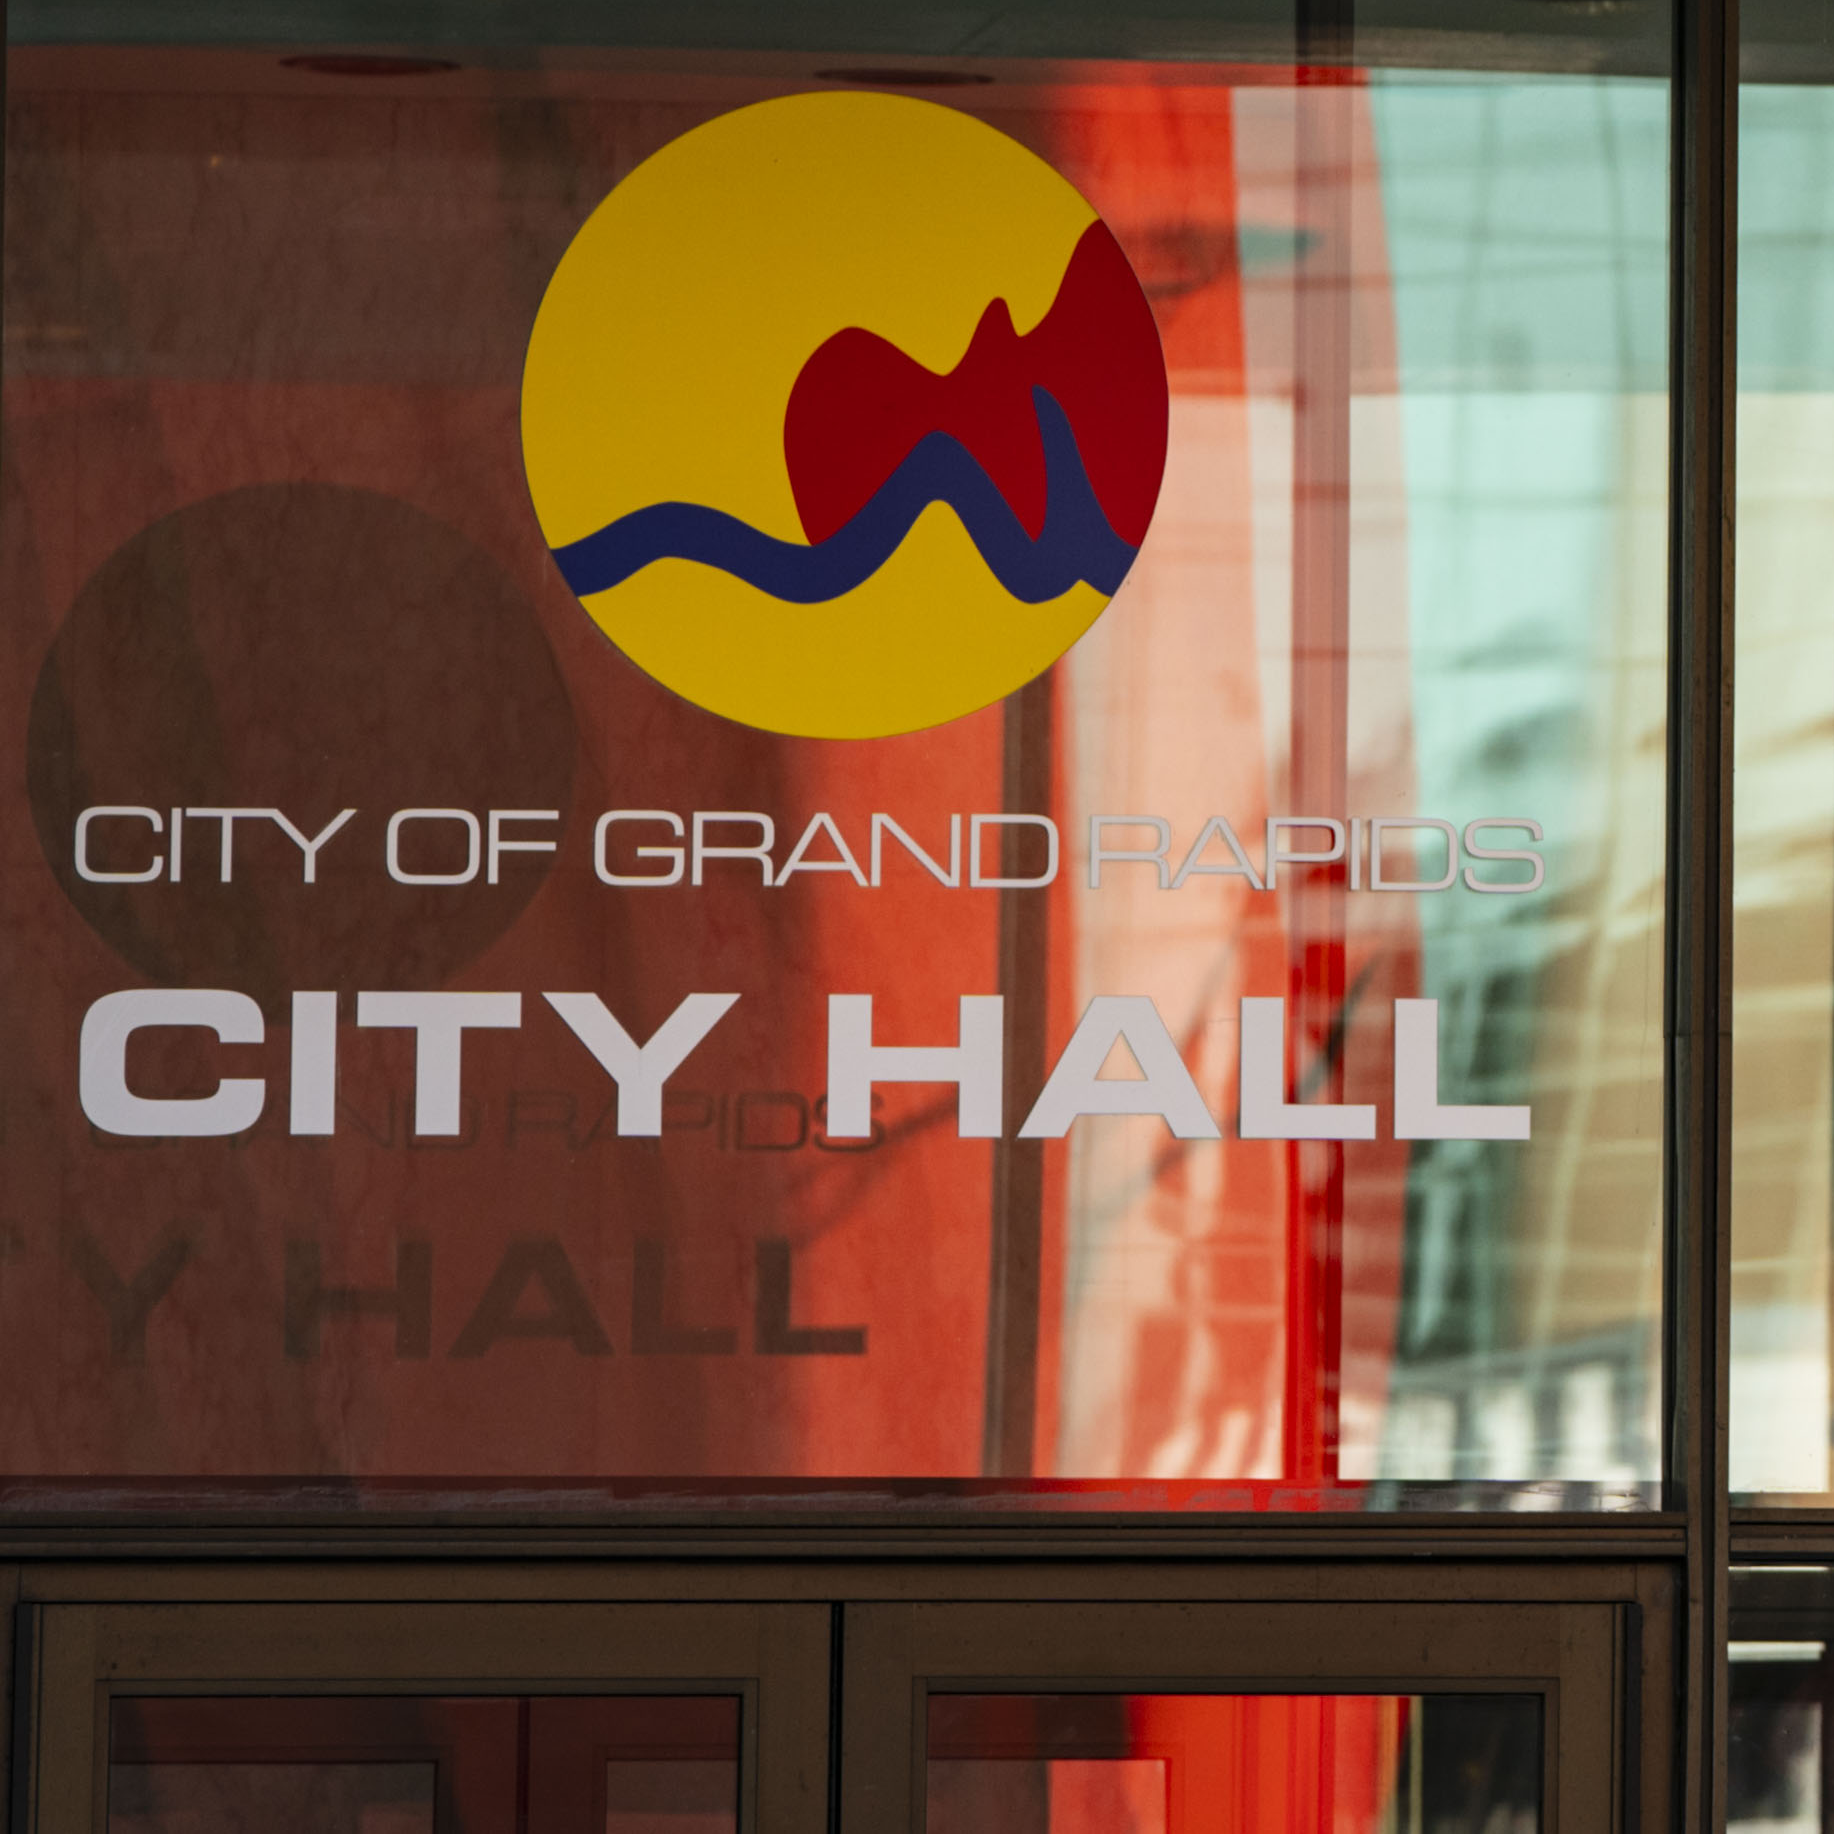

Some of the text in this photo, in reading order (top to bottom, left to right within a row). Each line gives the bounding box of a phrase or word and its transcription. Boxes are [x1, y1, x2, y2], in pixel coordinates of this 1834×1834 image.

[75, 807, 1546, 893] CITY OF GRAND RAPIDS
[80, 990, 740, 1136] CITY
[829, 995, 1532, 1139] HALL
[282, 1236, 866, 1358] HALL
